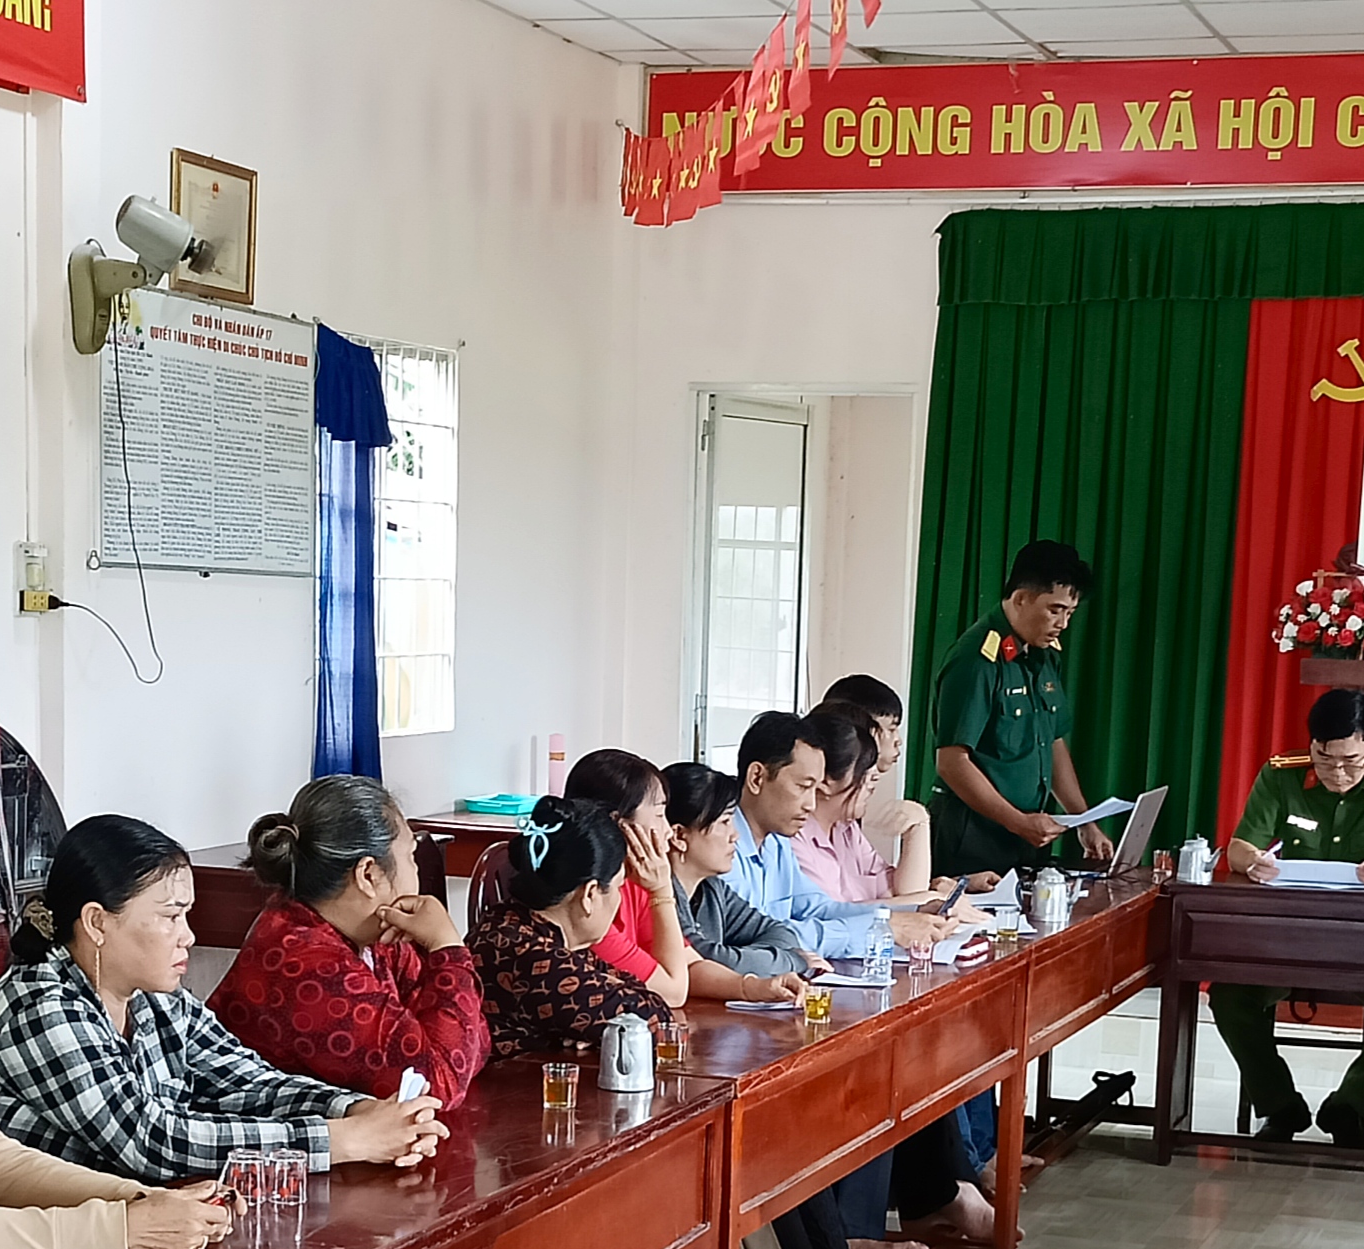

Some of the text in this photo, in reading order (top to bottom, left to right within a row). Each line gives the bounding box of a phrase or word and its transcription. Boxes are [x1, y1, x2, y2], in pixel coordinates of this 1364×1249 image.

[823, 96, 971, 167] CỘNG
[990, 90, 1102, 156] HÒA
[1120, 88, 1198, 152] XÃ
[1217, 87, 1316, 161] HỘI
